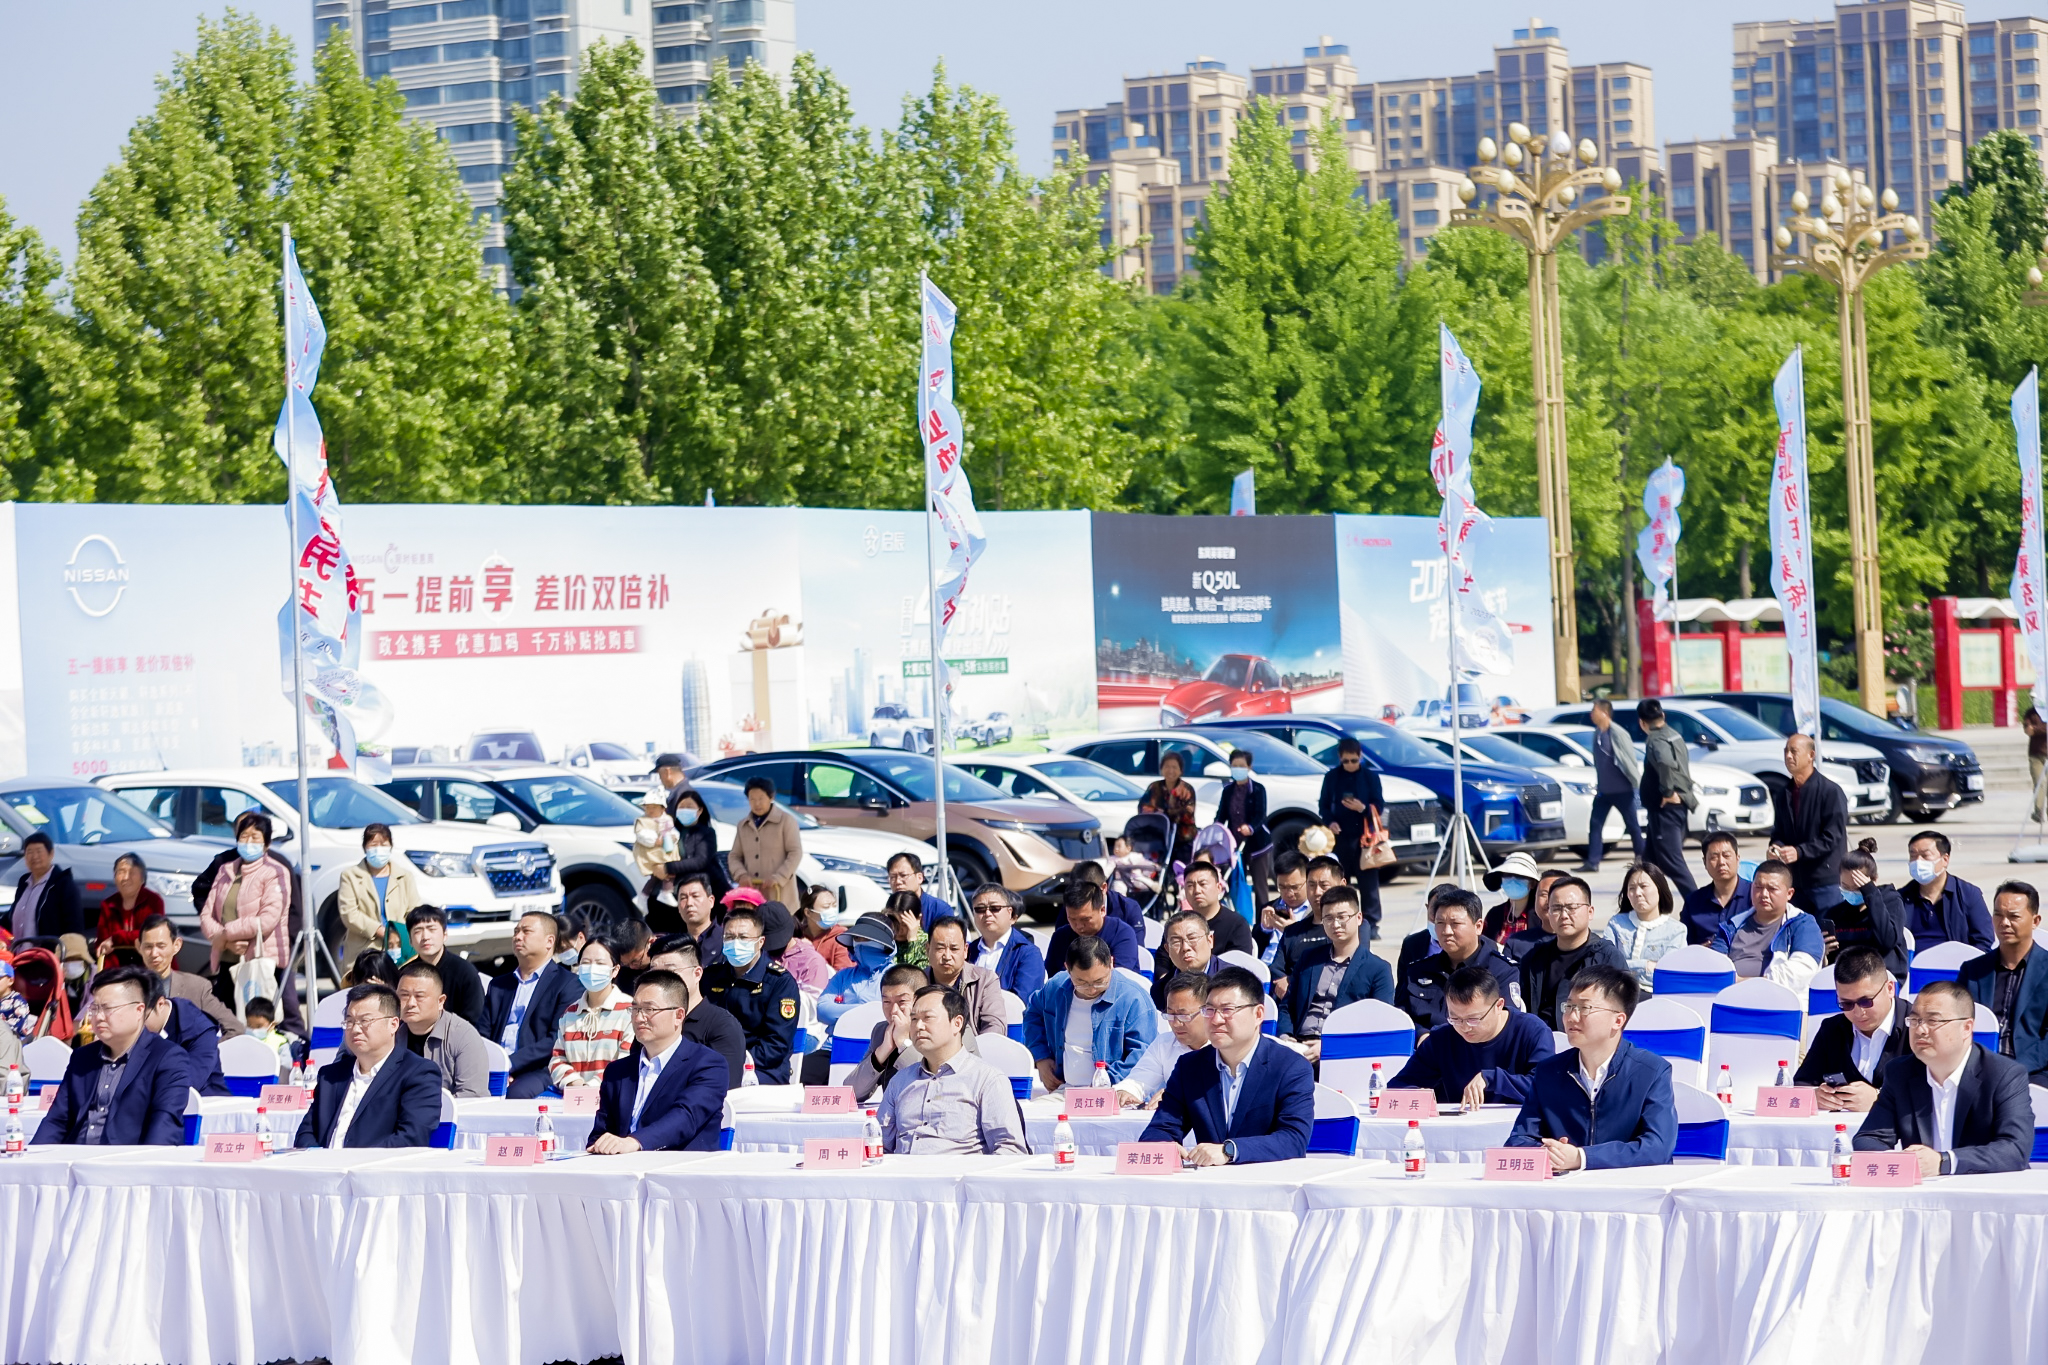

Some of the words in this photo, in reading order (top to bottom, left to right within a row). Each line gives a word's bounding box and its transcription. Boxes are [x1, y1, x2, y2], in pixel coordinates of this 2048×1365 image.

[882, 531, 905, 551] 启辰
[64, 568, 129, 583] NISSAN
[358, 565, 514, 614] 五一提前享
[534, 574, 670, 612] 差价双倍补
[378, 633, 443, 657] 政企携手
[455, 632, 520, 655] 优惠加码
[531, 629, 636, 652] 千万补贴抢购惠
[267, 1094, 293, 1104] 张亚伟
[811, 1094, 841, 1106] 张丙寅
[1074, 1096, 1106, 1109] 员江锋
[214, 1142, 245, 1155] 高立中
[1128, 1152, 1165, 1165] 荣旭光
[1495, 1158, 1535, 1171] 卫明远
